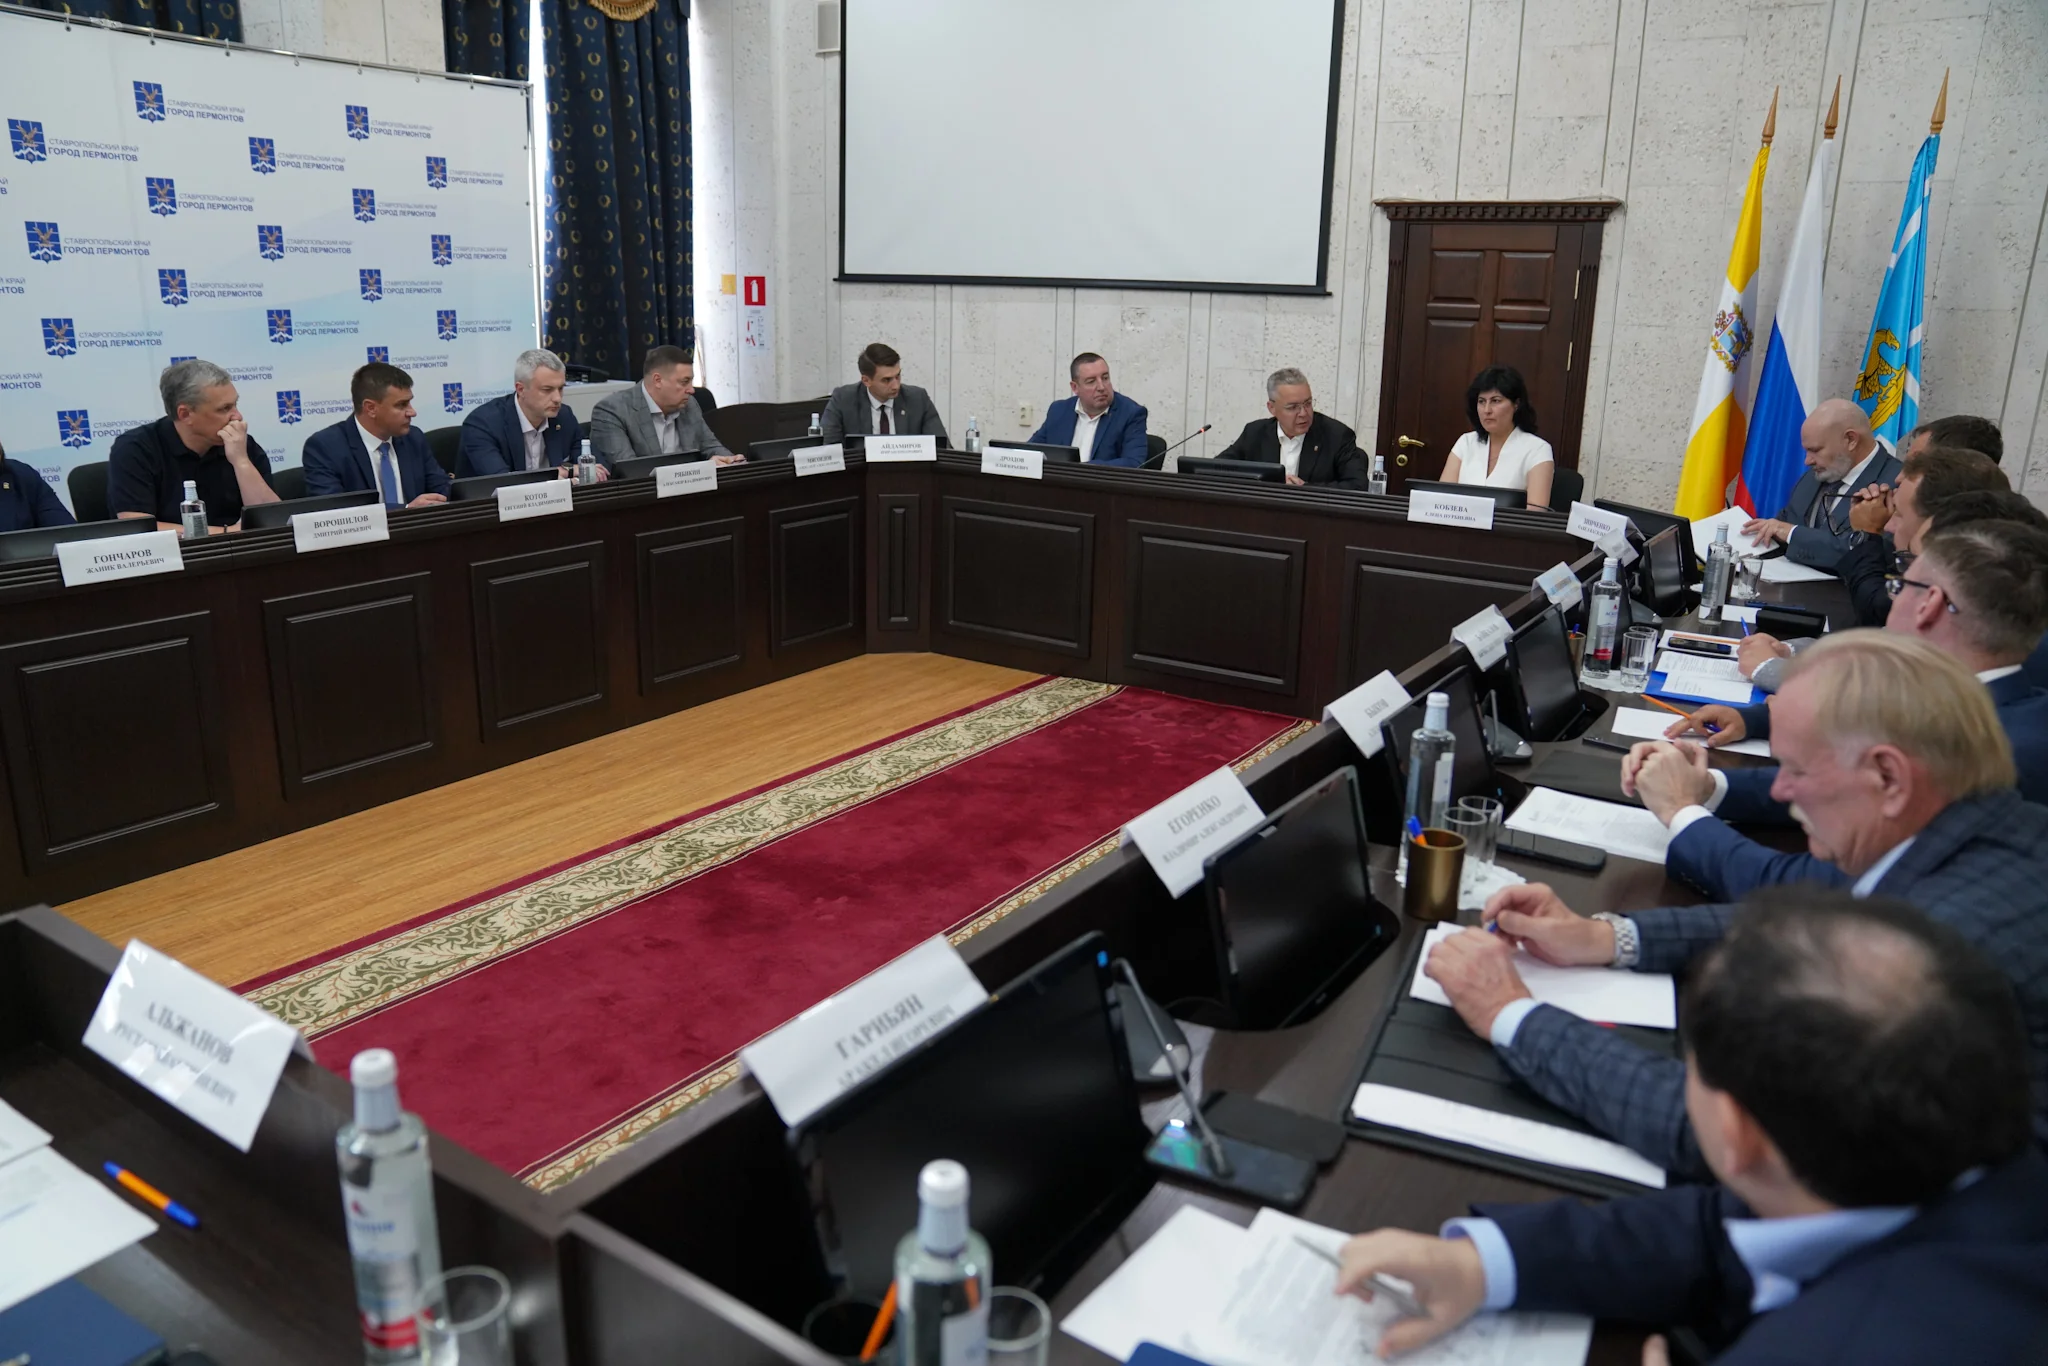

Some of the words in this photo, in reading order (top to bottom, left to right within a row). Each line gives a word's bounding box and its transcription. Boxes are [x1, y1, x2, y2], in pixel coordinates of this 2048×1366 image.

[167, 107, 195, 118] ГОРОД
[196, 110, 244, 123] ЛЕРМОНТОВ
[370, 127, 393, 136] ГОРОД
[393, 129, 431, 139] ЛЕРМОНТОВ
[49, 138, 120, 151] СТАВРОПОЛЬСКИЙ
[48, 147, 81, 158] ГОРОД
[82, 150, 138, 162] ЛЕРМОНТОВ
[277, 161, 302, 169] ГОРОД
[302, 162, 344, 172] ЛЕРМОНТОВ
[448, 176, 468, 184] ГОРОД
[468, 177, 503, 186] ЛЕРМОНТОВ
[178, 201, 205, 210] ГОРОД
[206, 202, 253, 212] ЛЕРМОНТОВ
[377, 208, 398, 217] ГОРОД
[399, 210, 436, 218] ЛЕРМОНТОВ
[64, 238, 132, 247] СТАВРОПОЛЬСКИЙ
[63, 246, 94, 255] ГОРОД
[97, 247, 150, 256] ЛЕРМОНТОВ
[286, 245, 309, 254] ГОРОД
[310, 246, 351, 254] ЛЕРМОНТОВ
[190, 290, 216, 298] ГОРОД
[217, 290, 263, 298] ЛЕРМОНТОВ
[405, 287, 442, 295] ЛЕРМОНТОВ
[318, 327, 359, 335] ЛЕРМОНТОВ
[478, 325, 511, 333] ЛЕРМОНТОВ
[79, 331, 145, 339] СТАВРОПОЛЬСКИЙ
[78, 339, 109, 348] ГОРОД
[110, 338, 162, 347] ЛЕРМОНТОВ
[412, 361, 448, 369] ЛЕРМОНТОВ
[0, 381, 41, 390] МОНТОВ
[327, 406, 353, 414] ЛЕРМОН
[93, 429, 122, 437] ГОРОД
[524, 493, 548, 501] КОТОВ
[1434, 503, 1468, 513] КОБЗЕВА
[314, 515, 369, 529] ВОРОШИЛОВ
[313, 528, 343, 539] ДМИТРИЙ
[94, 549, 152, 564] ГОНЧАРОВ
[117, 557, 165, 570] ВАЛЕРЬЕВИЧ
[1167, 795, 1221, 835] ЕГОРЕНКО
[836, 994, 925, 1059] ГАРИБЯН
